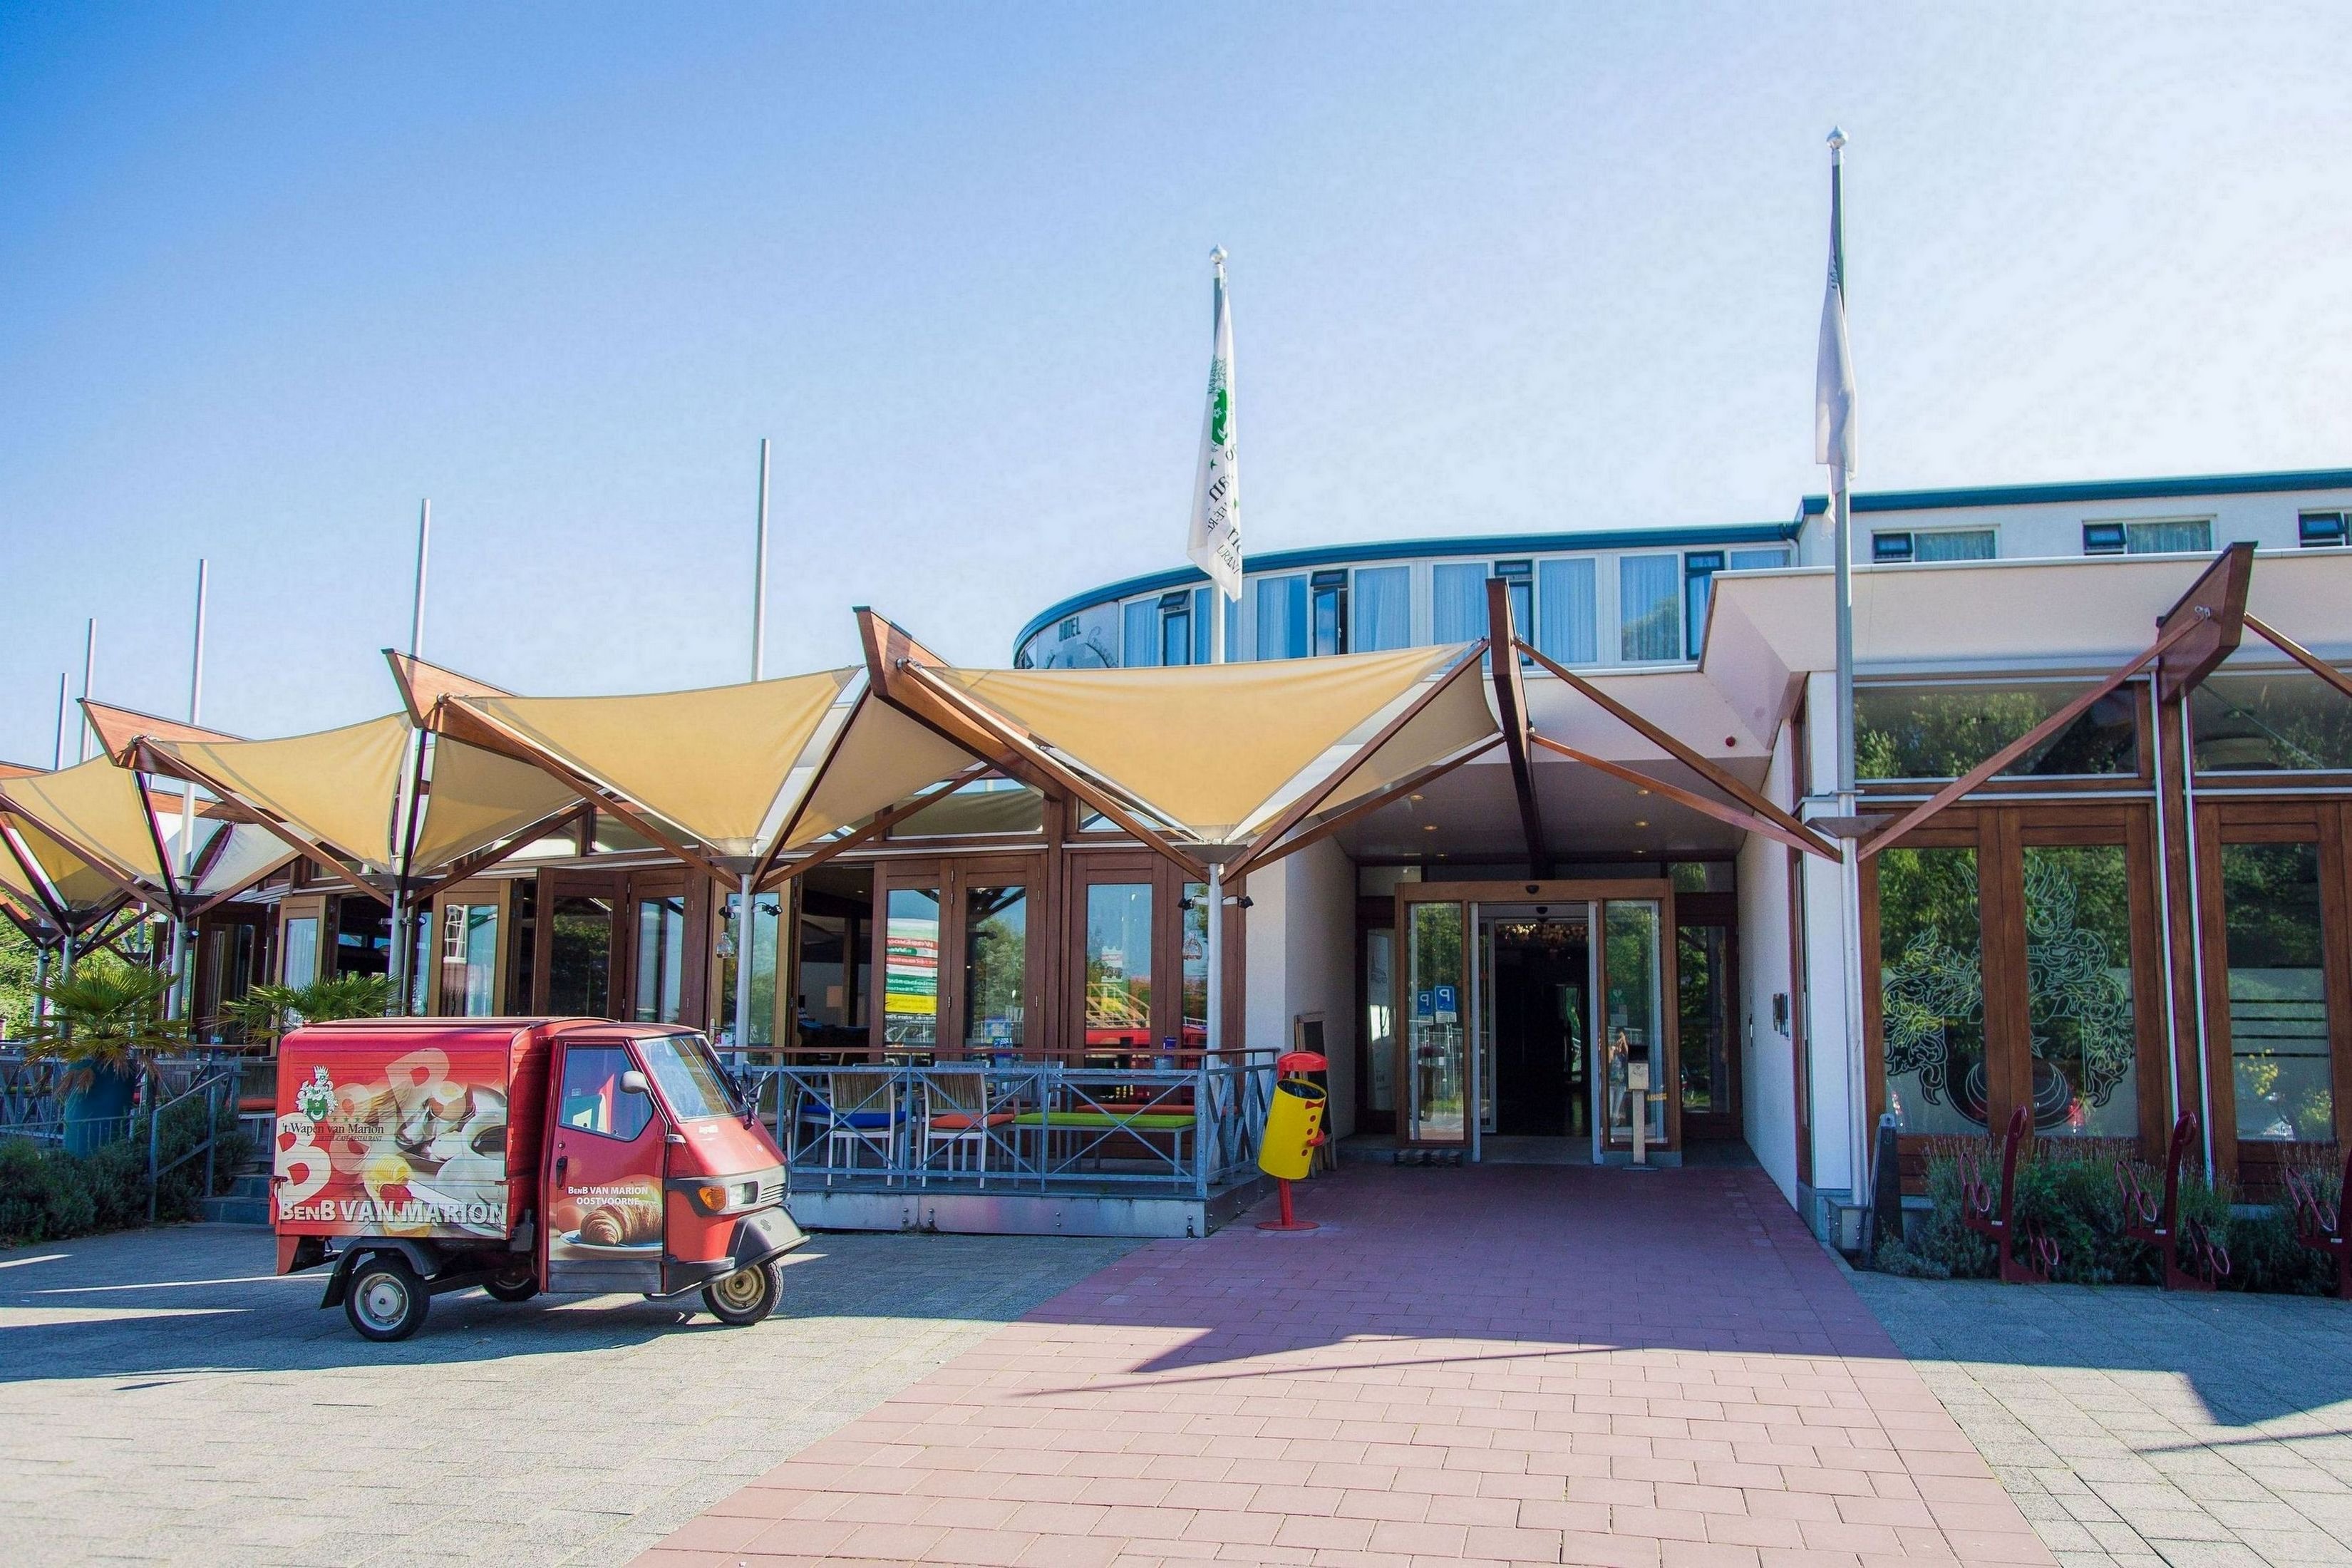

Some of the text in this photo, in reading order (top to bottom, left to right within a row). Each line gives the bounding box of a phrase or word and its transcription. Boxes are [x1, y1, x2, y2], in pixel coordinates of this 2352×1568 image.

[290, 1123, 324, 1136] Wapen
[327, 1125, 345, 1134] van
[347, 1123, 384, 1134] Marion
[340, 1200, 398, 1223] VAN
[399, 1201, 507, 1224] MARION
